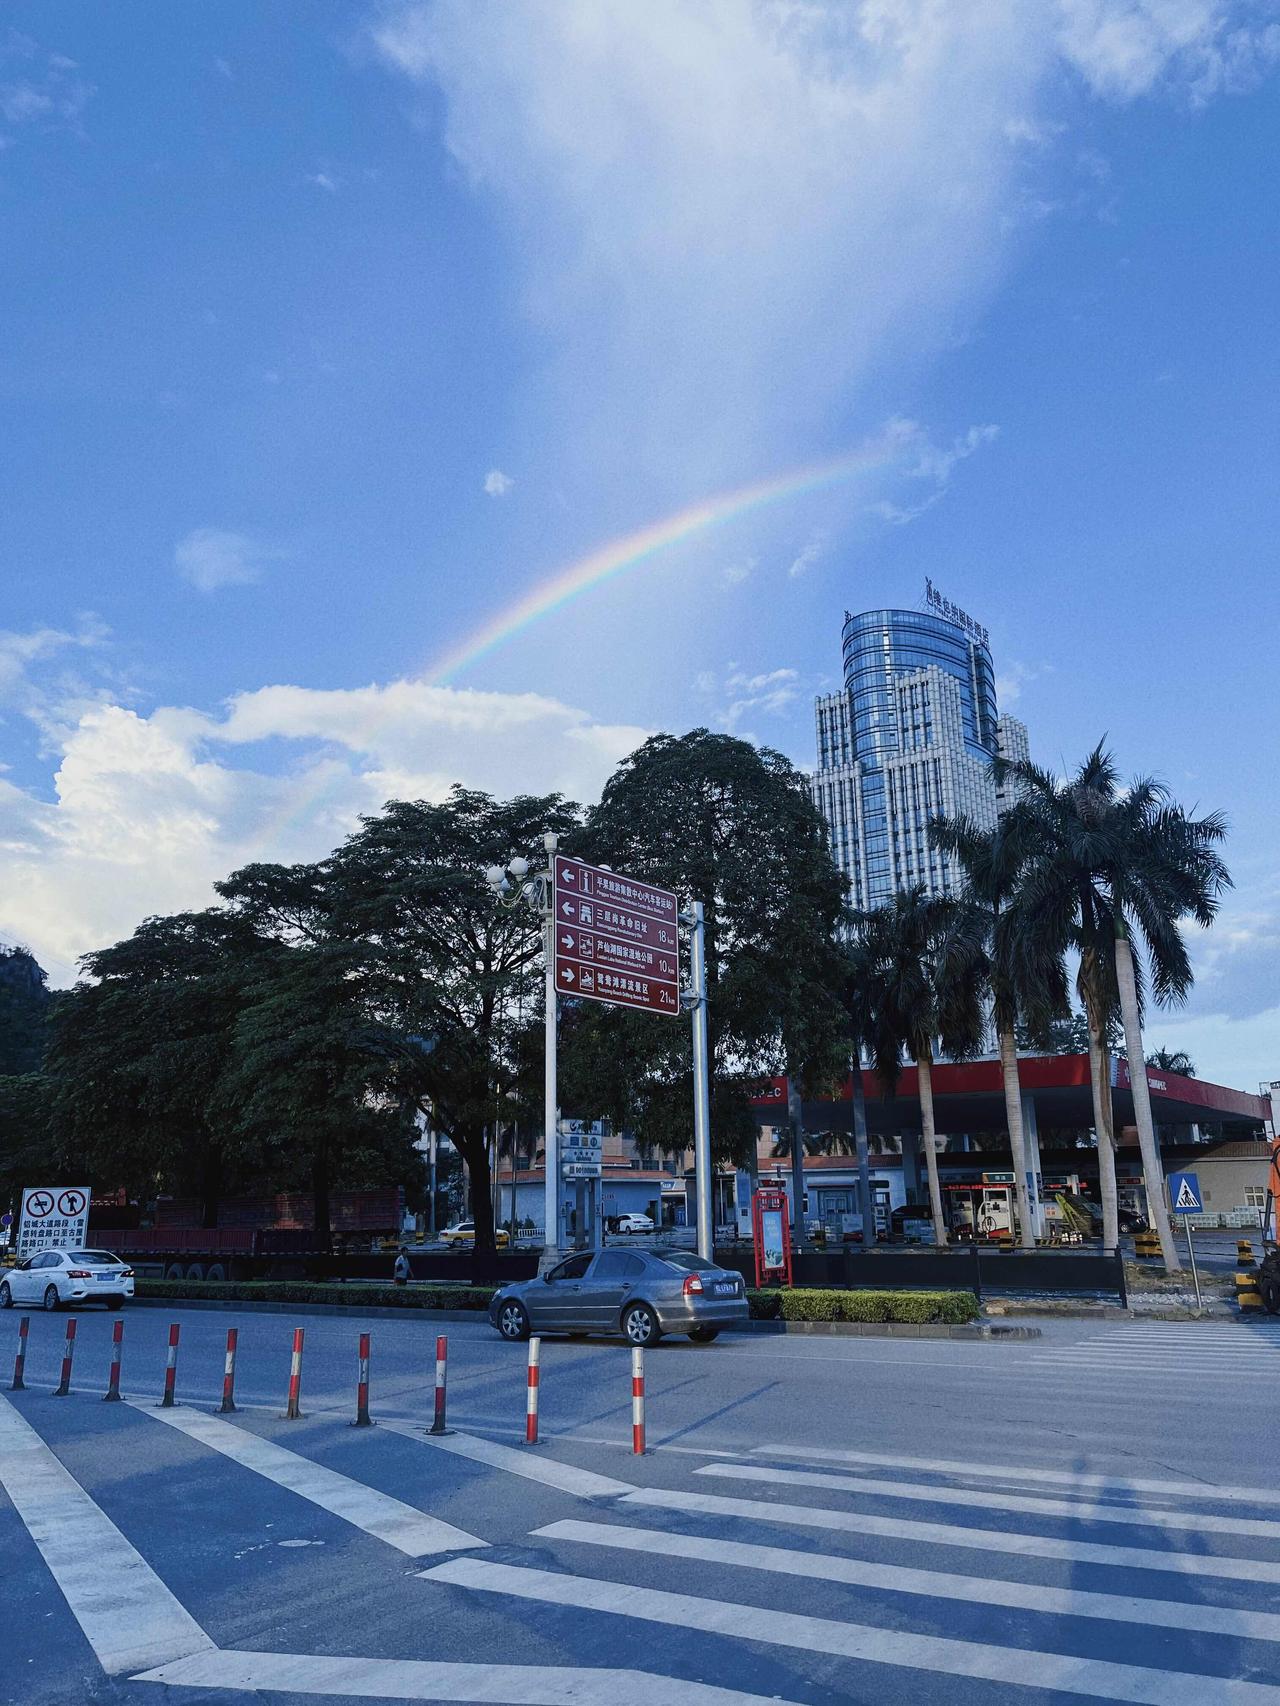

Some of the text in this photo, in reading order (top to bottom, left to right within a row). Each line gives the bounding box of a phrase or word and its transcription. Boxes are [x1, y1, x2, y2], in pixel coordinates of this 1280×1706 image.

[933, 588, 989, 643] 维也纳国际酒店
[658, 929, 667, 943] 18
[659, 959, 668, 973] 10
[660, 989, 669, 1003] 21
